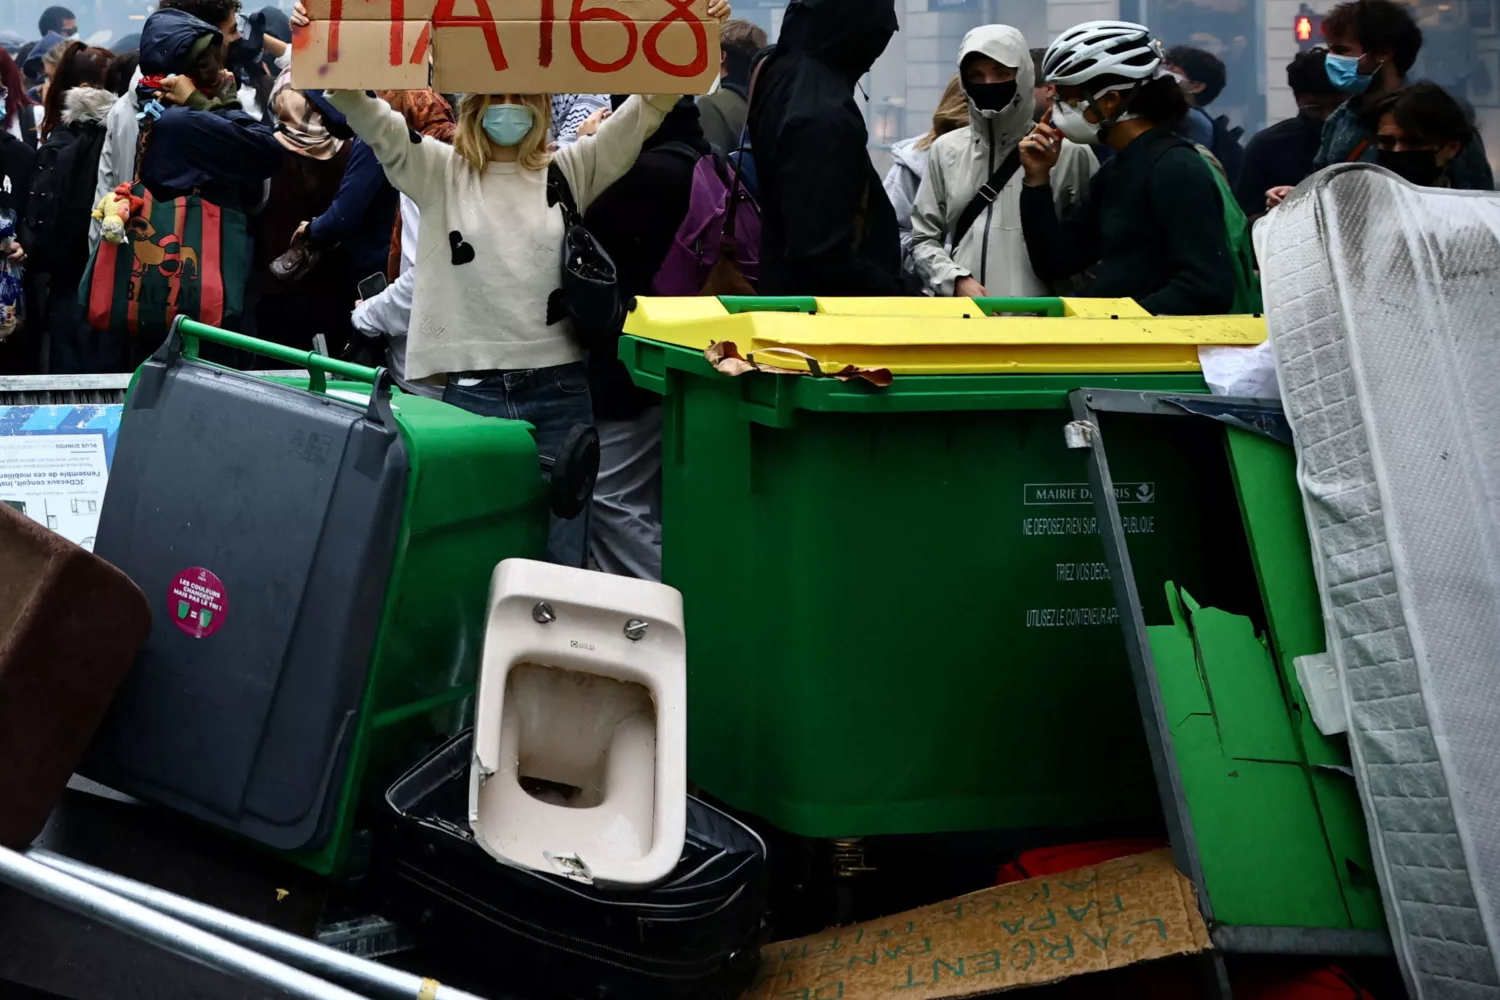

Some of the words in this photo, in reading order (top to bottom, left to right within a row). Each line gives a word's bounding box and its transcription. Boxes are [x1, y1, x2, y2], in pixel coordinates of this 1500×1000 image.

[1036, 489, 1076, 499] MAIRIE
[1112, 488, 1130, 498] RIS
[1024, 518, 1032, 535] NE
[1034, 517, 1065, 534] DEPOSEZ
[1066, 517, 1081, 534] RIEN
[1083, 517, 1096, 534] SUR
[1123, 516, 1154, 533] PUBLIQUE
[1056, 563, 1074, 580] TRIEZ
[1076, 563, 1089, 580] VOS
[180, 578, 190, 586] LES
[191, 583, 221, 598] COULEURS
[174, 588, 188, 598] MAIS
[188, 594, 200, 603] PAS
[209, 602, 218, 610] TRI
[1026, 609, 1055, 627] UTILISEZ
[1056, 608, 1064, 625] LE
[1066, 607, 1106, 625] CONTENEUR
[891, 916, 1169, 991] L'ARGENT
